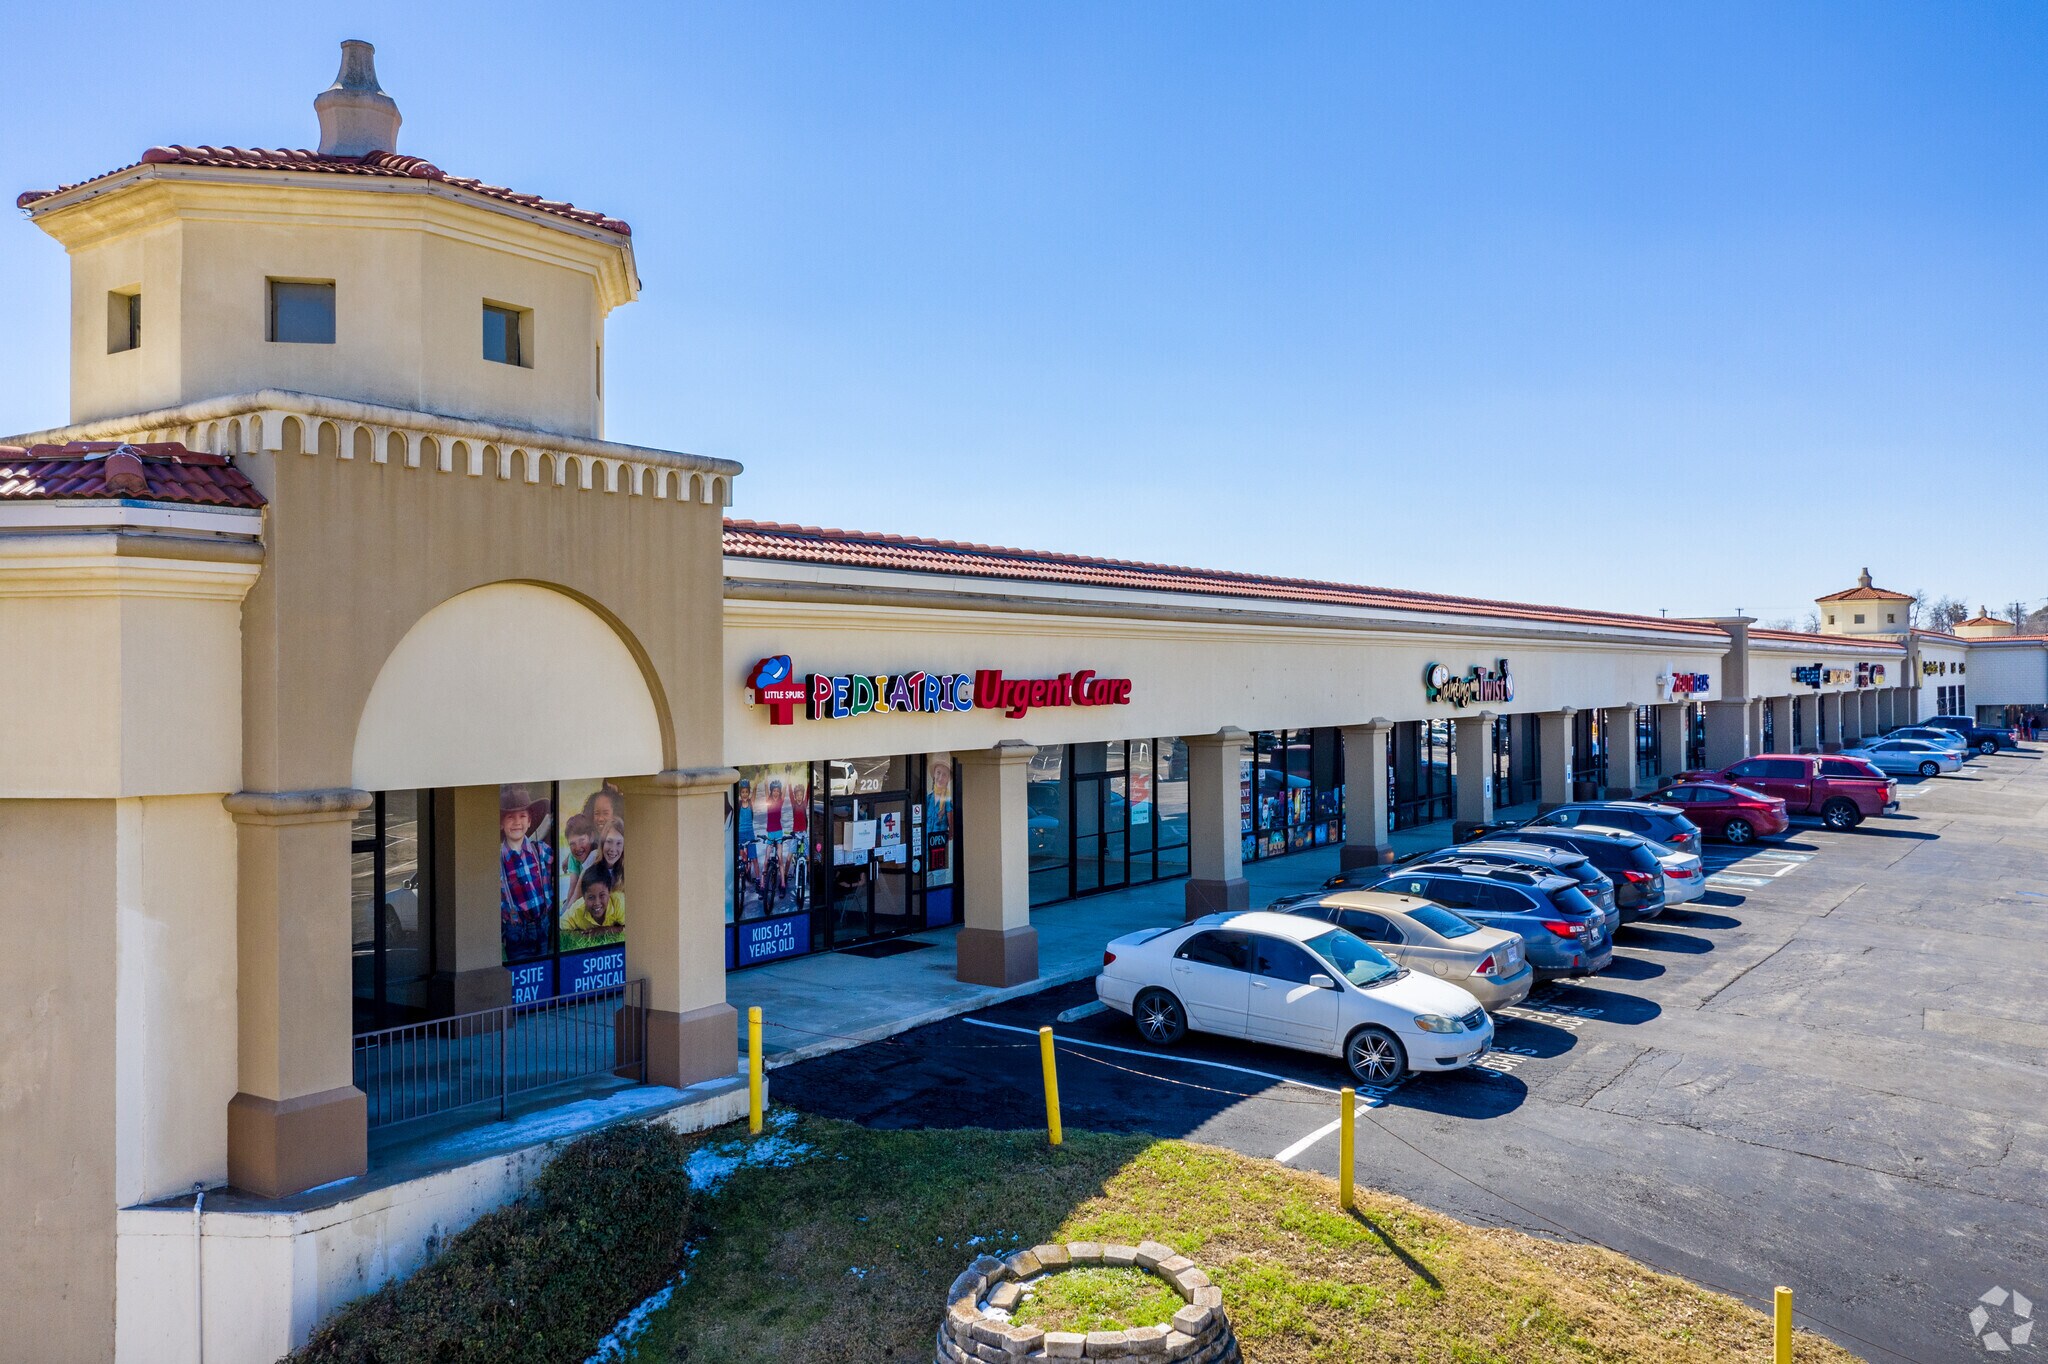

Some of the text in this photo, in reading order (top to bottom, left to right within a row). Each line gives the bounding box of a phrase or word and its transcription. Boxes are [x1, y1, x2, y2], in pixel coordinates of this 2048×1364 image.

[1474, 667, 1506, 702] Twist
[764, 690, 805, 700] LITTLE SPURS
[808, 669, 1133, 721] PEDIATRIC Urgent Care
[859, 778, 879, 791] 220
[929, 835, 946, 847] OPEN
[752, 922, 792, 942] KIDS 0-21
[749, 936, 795, 958] YEARS OLD
[583, 953, 623, 974] SPORTS
